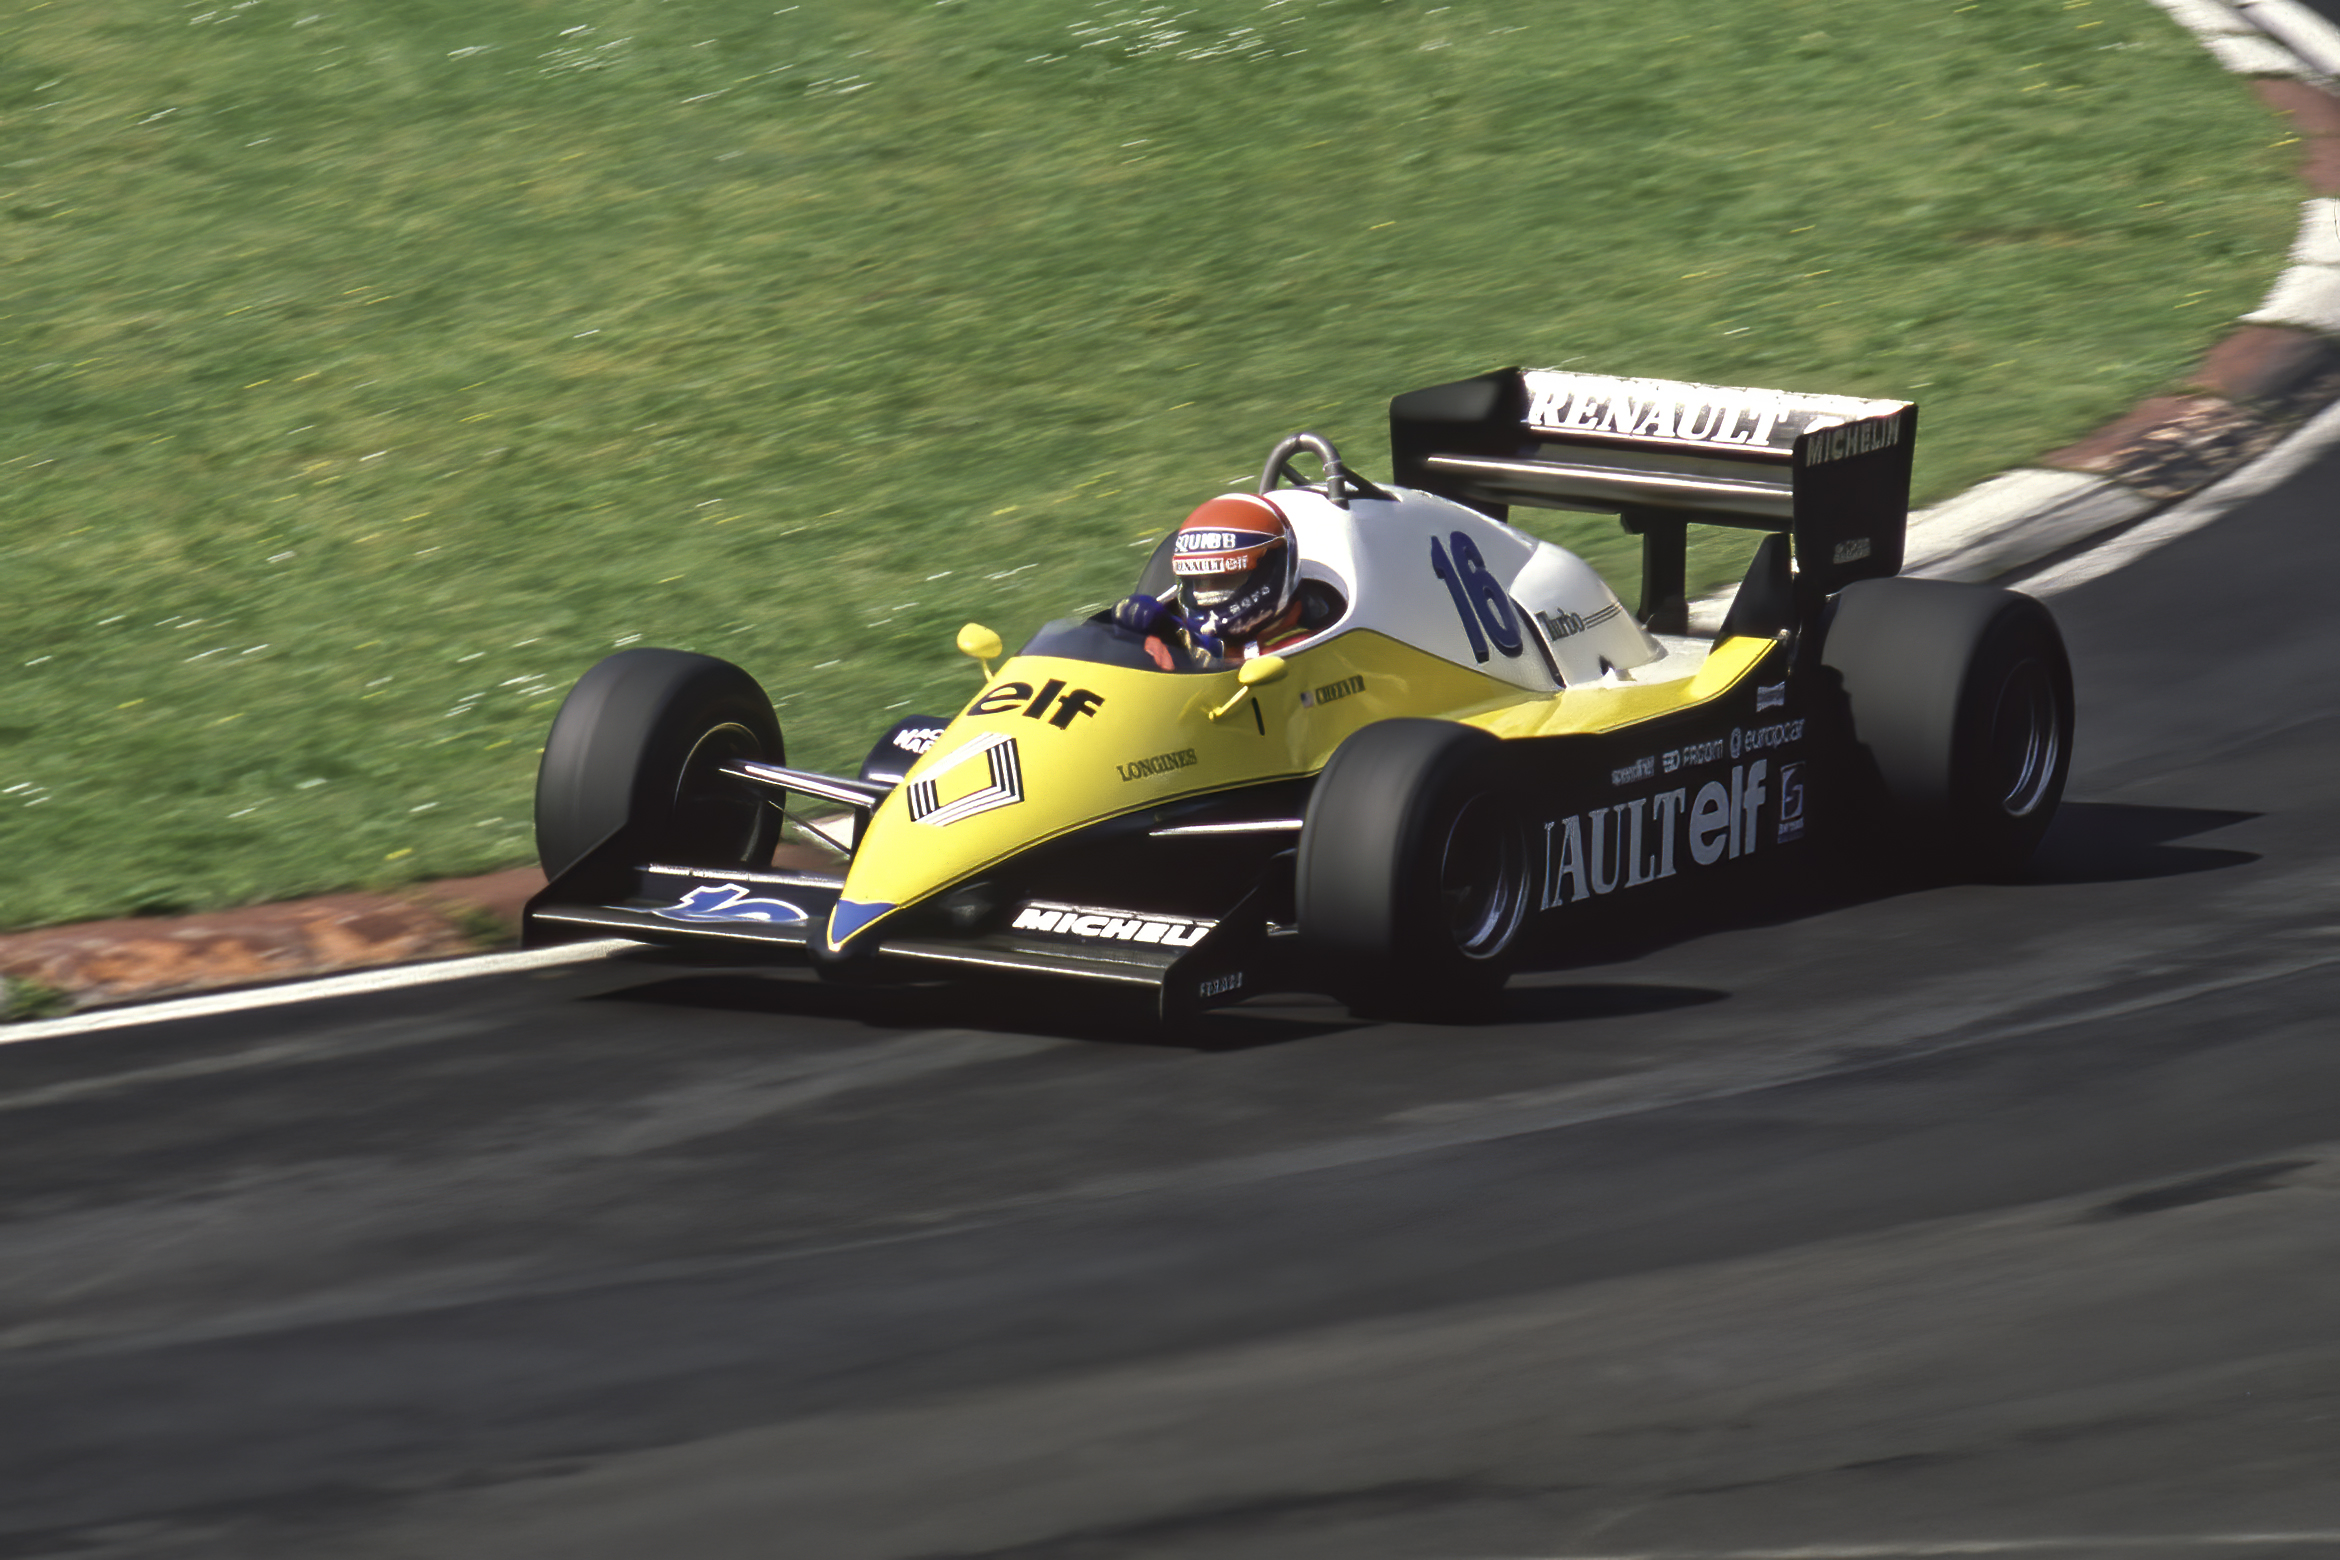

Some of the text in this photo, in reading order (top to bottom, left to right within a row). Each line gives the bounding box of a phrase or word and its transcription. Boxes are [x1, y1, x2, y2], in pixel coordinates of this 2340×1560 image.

[1528, 390, 1790, 446] RENAULT
[1805, 415, 1900, 468] MICHELIN
[1430, 530, 1524, 664] 16
[966, 678, 1105, 730] elf
[1745, 718, 1805, 752] europcar
[1116, 748, 1197, 782] LONGINES
[1689, 759, 1767, 866] elf
